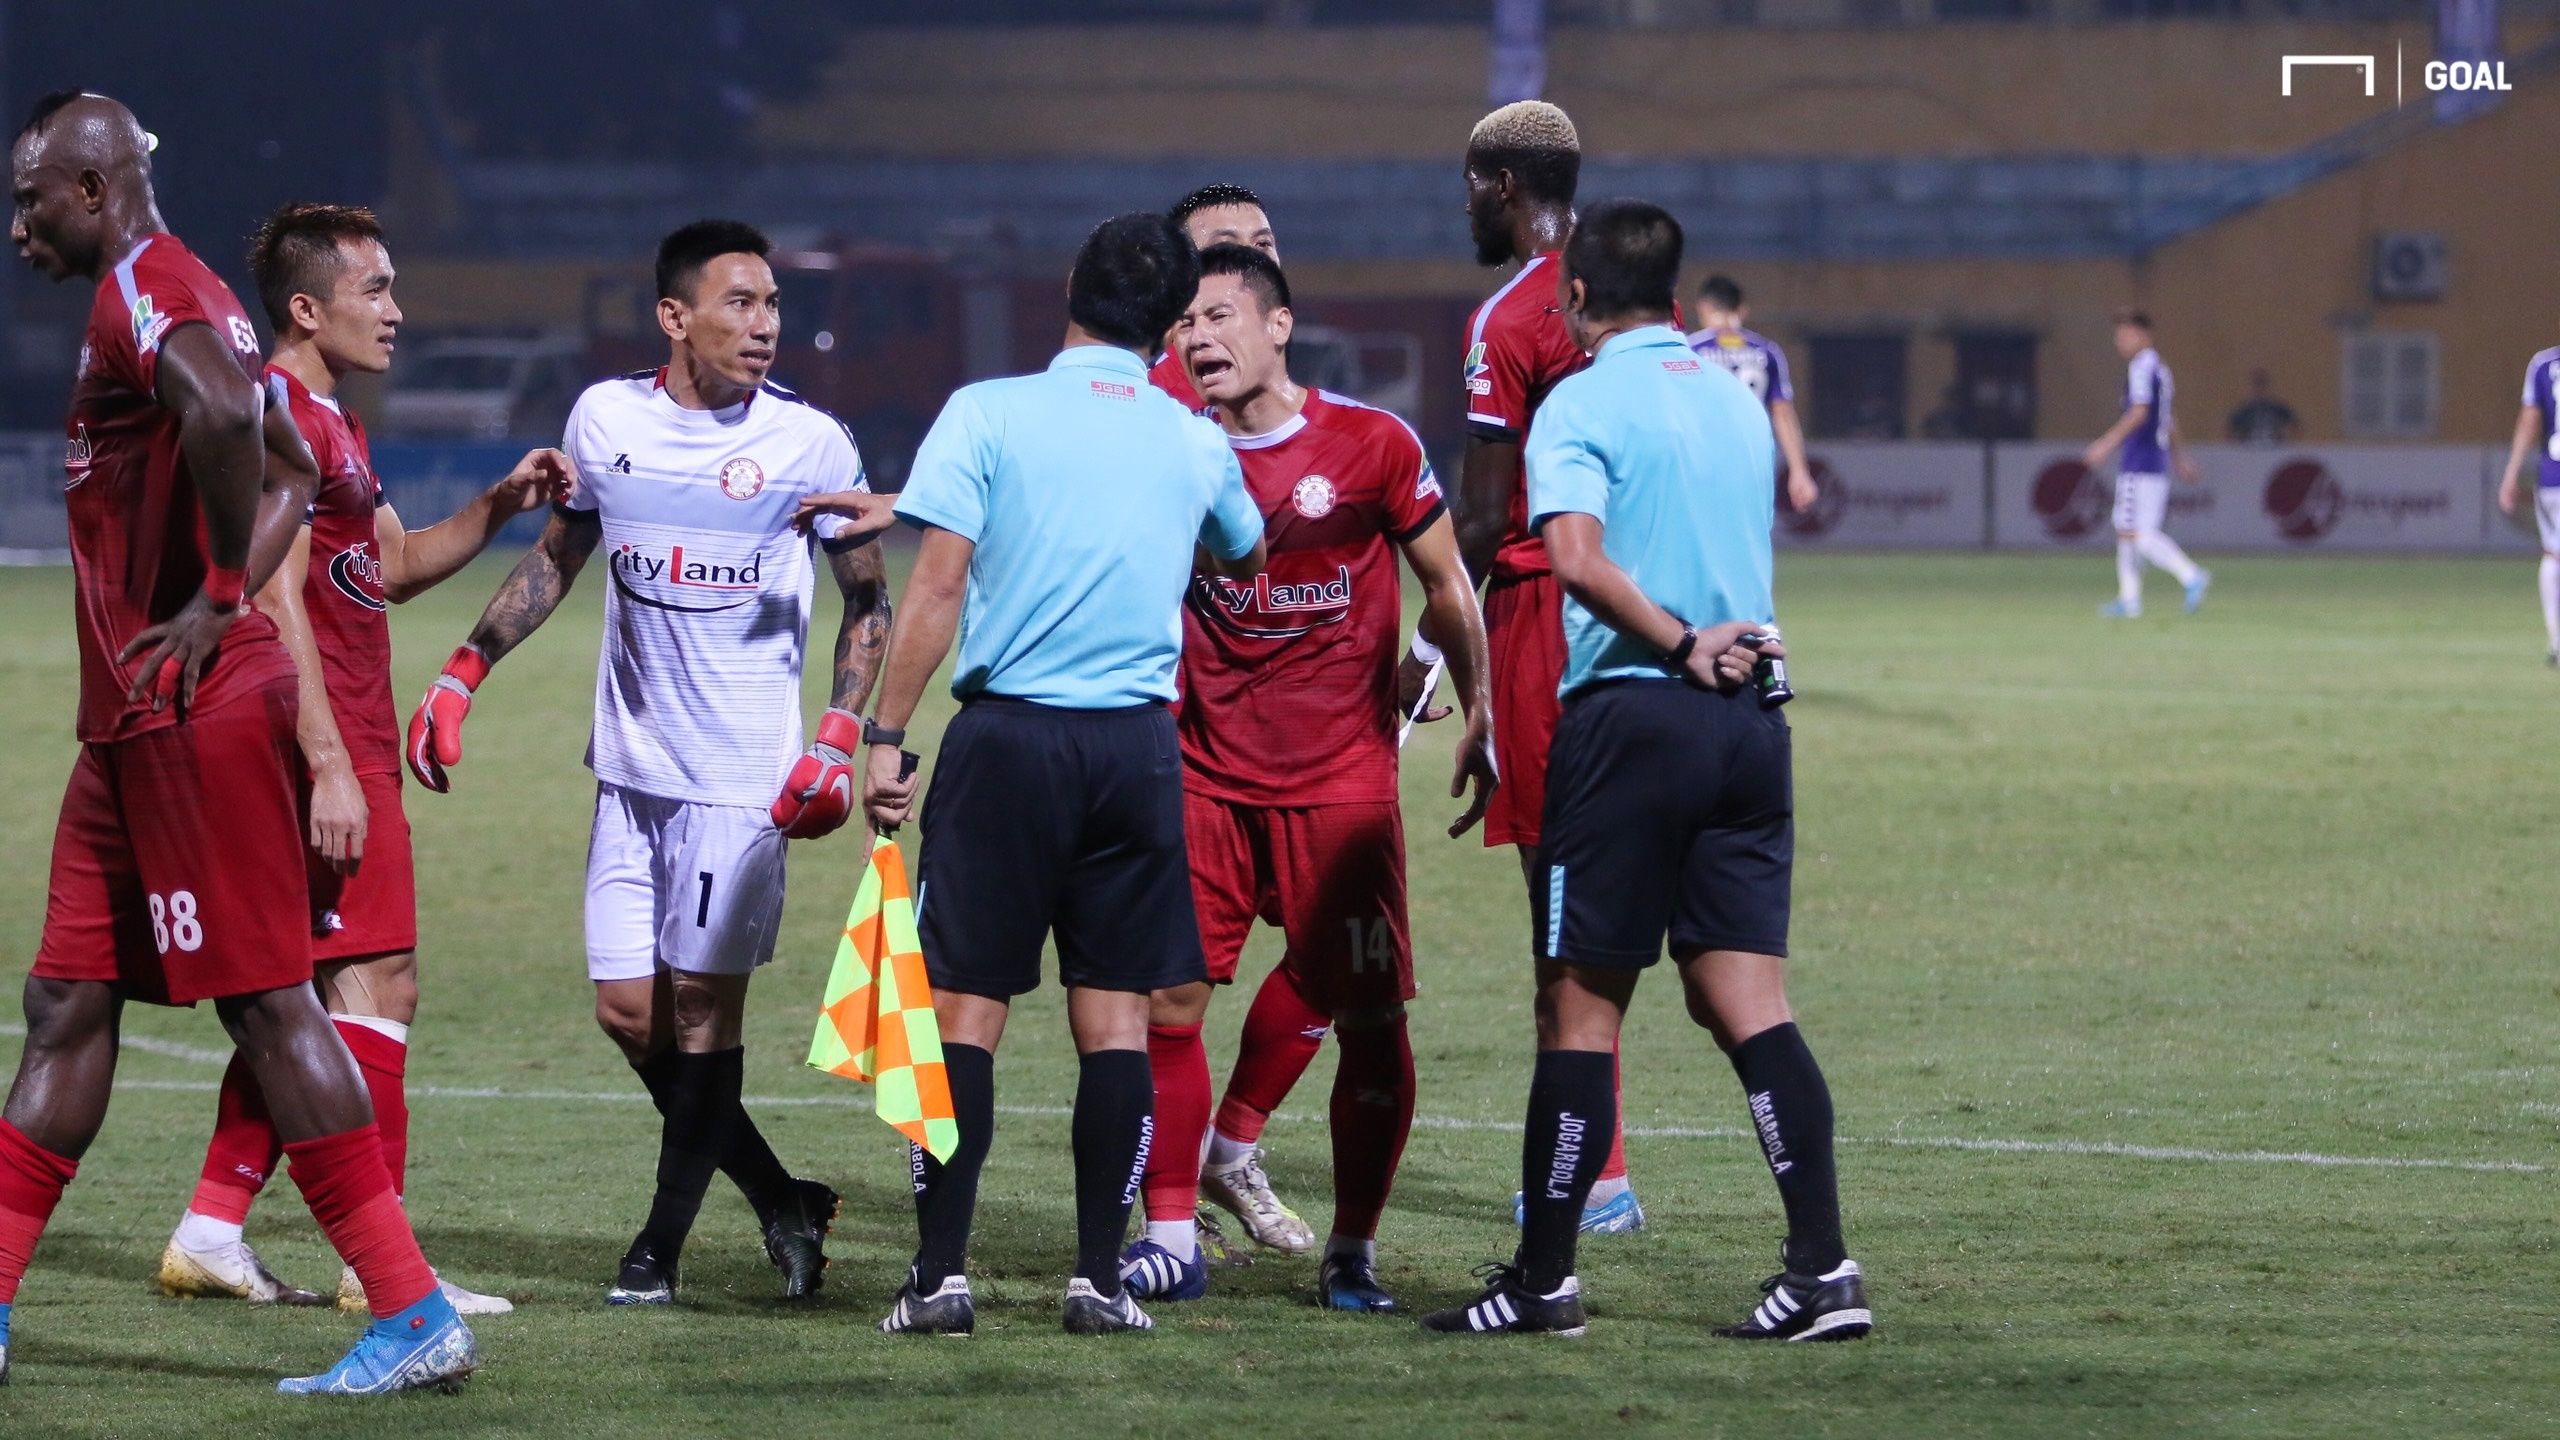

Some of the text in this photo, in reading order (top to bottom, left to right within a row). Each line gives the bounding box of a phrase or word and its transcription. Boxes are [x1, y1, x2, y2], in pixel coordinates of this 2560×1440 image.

[149, 890, 203, 954] 88
[697, 871, 713, 928] 1
[1345, 916, 1391, 973] 14
[1546, 1112, 1586, 1198] JOGARBOLA
[1750, 1091, 1793, 1174] JOGARBOLA
[911, 1140, 927, 1193] RBOLA
